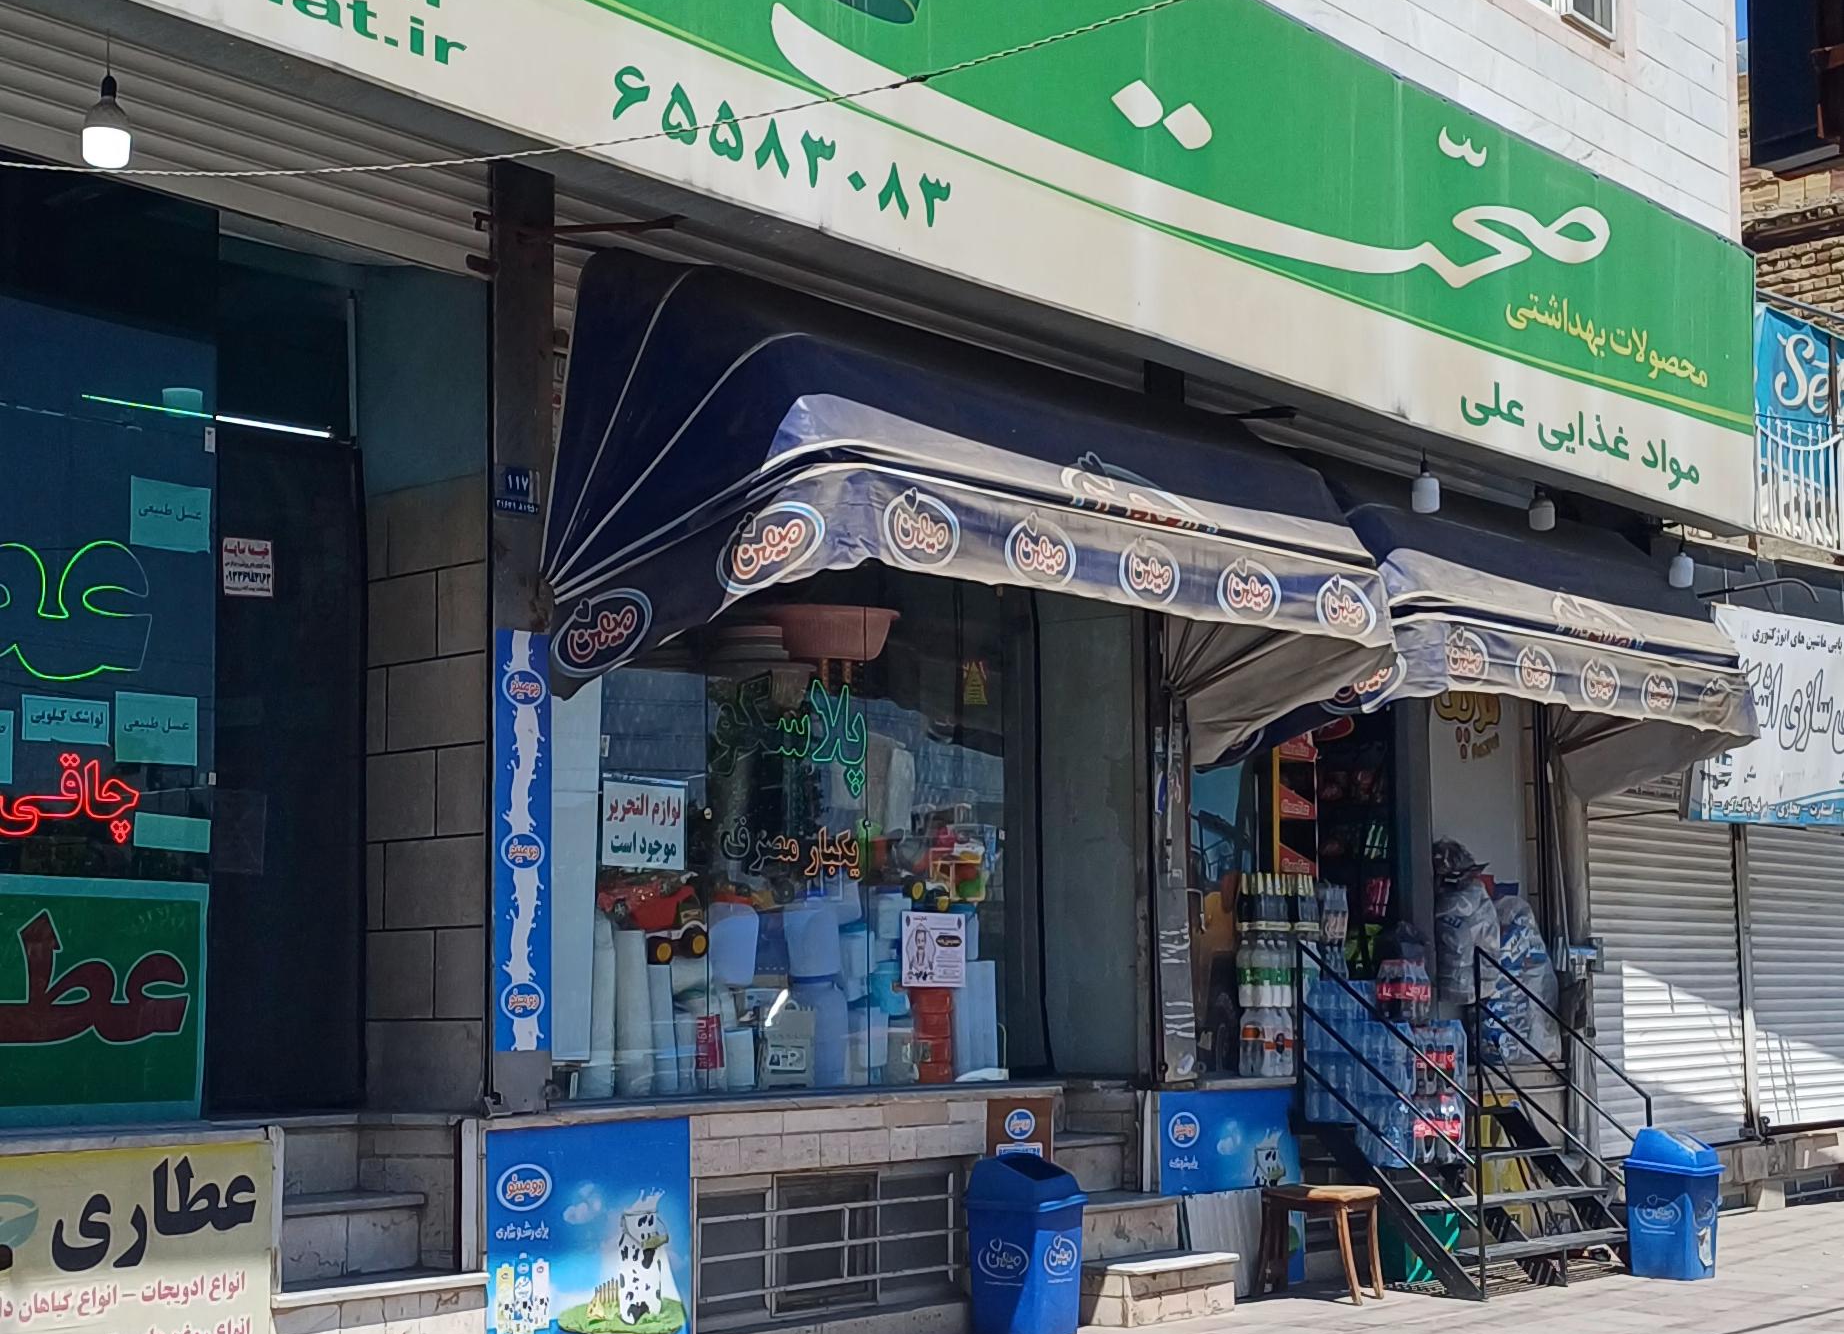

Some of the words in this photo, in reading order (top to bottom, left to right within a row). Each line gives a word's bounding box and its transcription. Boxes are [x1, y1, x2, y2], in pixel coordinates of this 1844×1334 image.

[612, 65, 951, 227] ۶۵۵۸۳۰۸۳
[1504, 294, 1606, 357] بهداشتی
[1609, 327, 1708, 388] محصولات
[1460, 381, 1525, 427] علی
[1537, 410, 1630, 461] غذایی
[1640, 438, 1700, 491] مواد
[731, 518, 807, 579] میهن
[895, 508, 949, 555] میهن
[1015, 529, 1067, 576] میهن
[1128, 551, 1173, 595] میهن
[1226, 572, 1273, 612] میهن
[709, 670, 867, 797] پلاسکو
[606, 793, 649, 822] التحریر
[652, 795, 681, 826] لوازم
[610, 830, 636, 854] است
[636, 836, 677, 864] موجود
[724, 817, 800, 872] مصرف
[804, 826, 860, 877] یکبار
[506, 1173, 545, 1202] دومینو
[52, 1155, 258, 1273] عطاری
[77, 1284, 118, 1317] انواع
[141, 1275, 205, 1305] ادویجات
[209, 1271, 246, 1302] انواع
